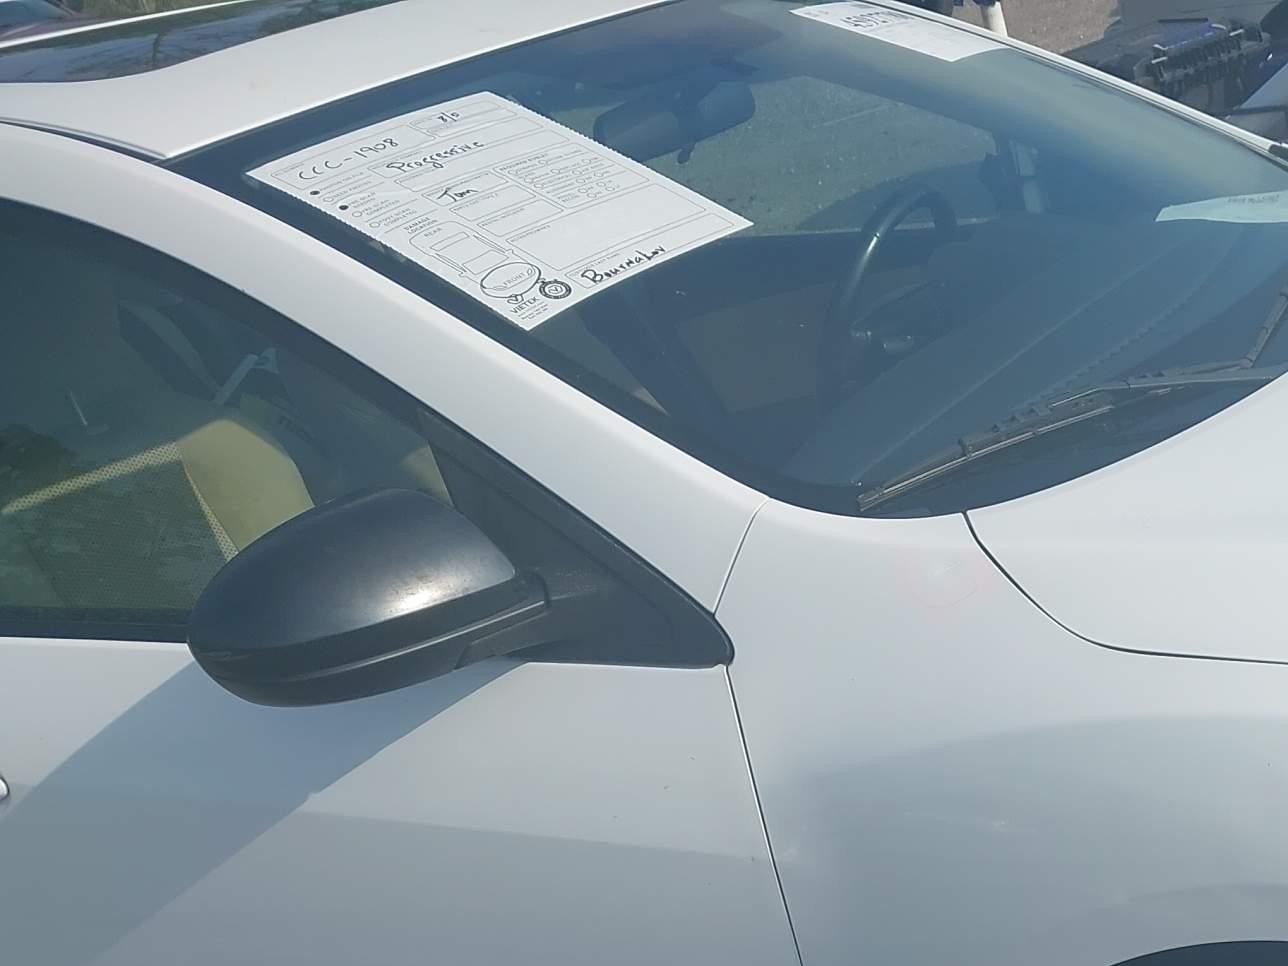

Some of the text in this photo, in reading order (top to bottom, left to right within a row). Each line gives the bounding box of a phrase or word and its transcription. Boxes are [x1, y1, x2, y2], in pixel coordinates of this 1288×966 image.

[385, 141, 485, 173] Progressive
[403, 216, 430, 231] DAMAGE
[407, 219, 438, 235] LOCATION
[503, 272, 525, 286] FRONT
[510, 296, 541, 314] VIETEK
